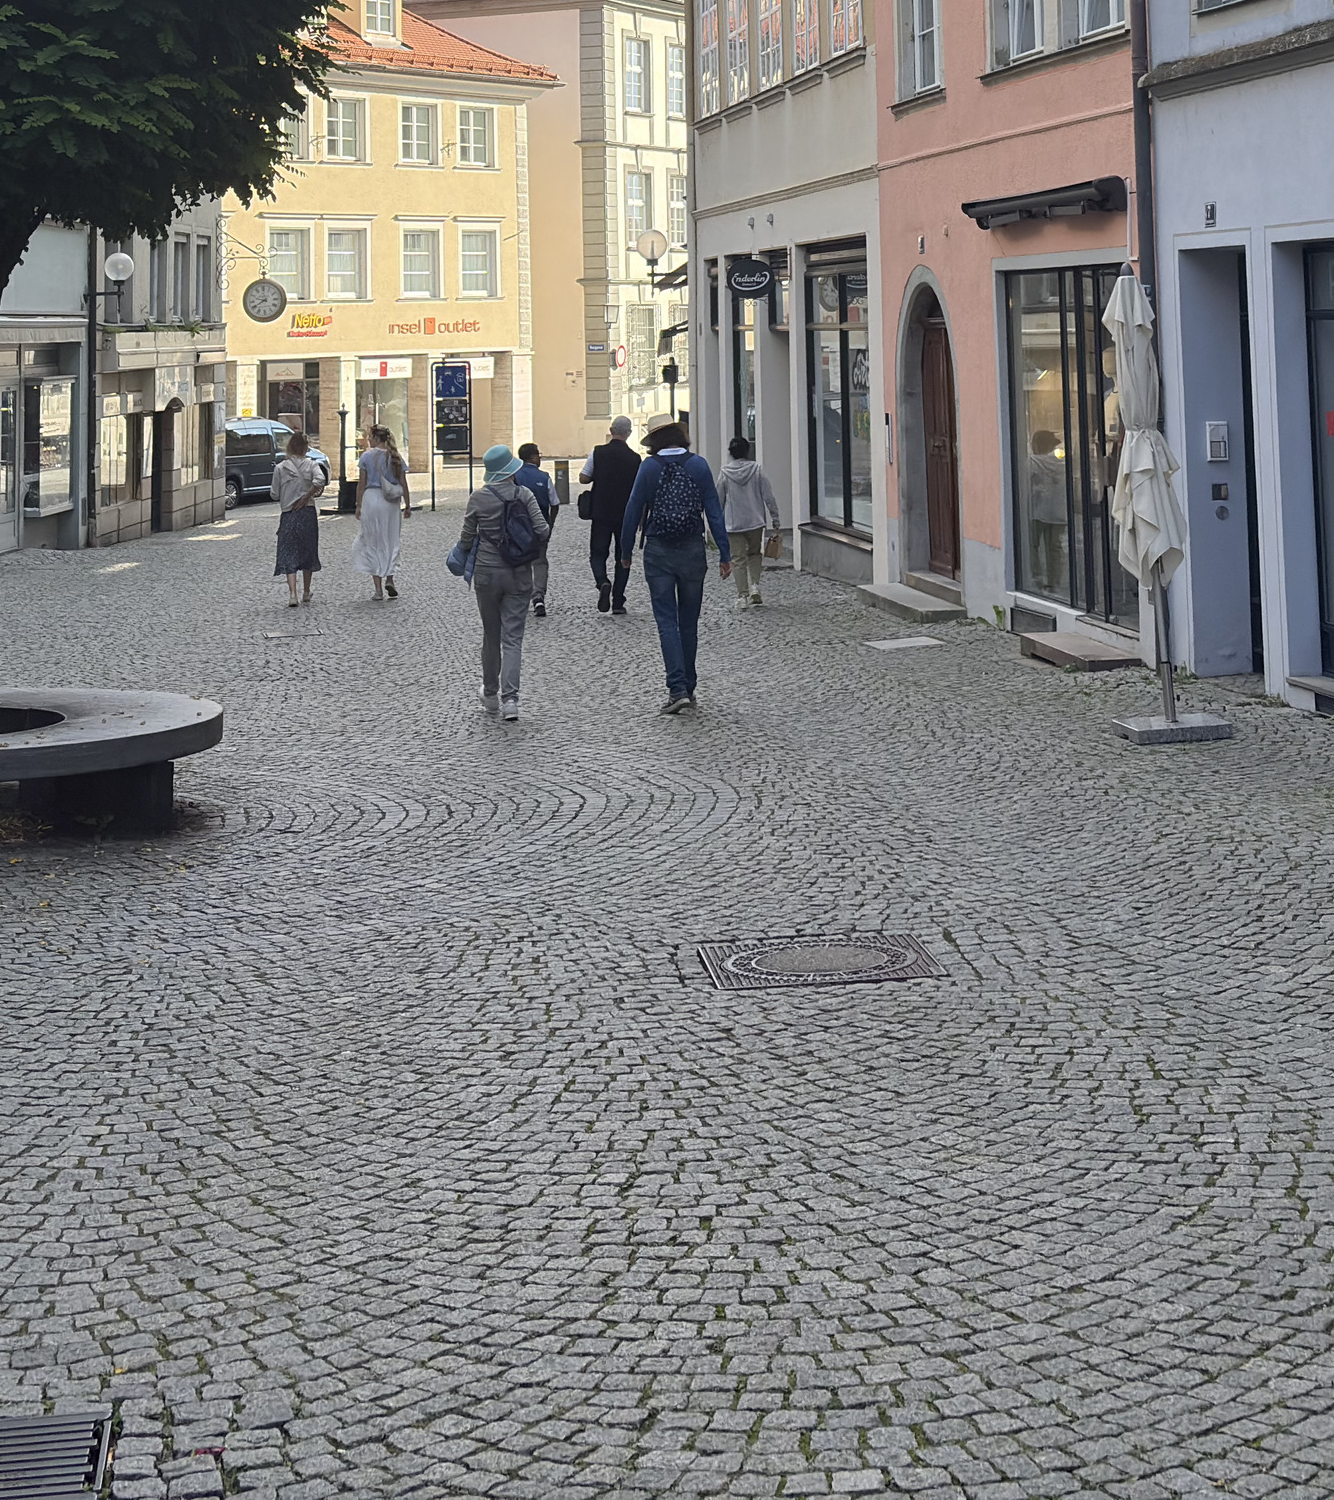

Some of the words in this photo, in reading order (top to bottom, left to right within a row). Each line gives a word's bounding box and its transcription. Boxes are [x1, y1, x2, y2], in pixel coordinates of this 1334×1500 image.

[733, 272, 766, 283] Enderlin
[292, 312, 324, 329] Netto
[388, 319, 421, 335] insel
[437, 318, 481, 334] outlet
